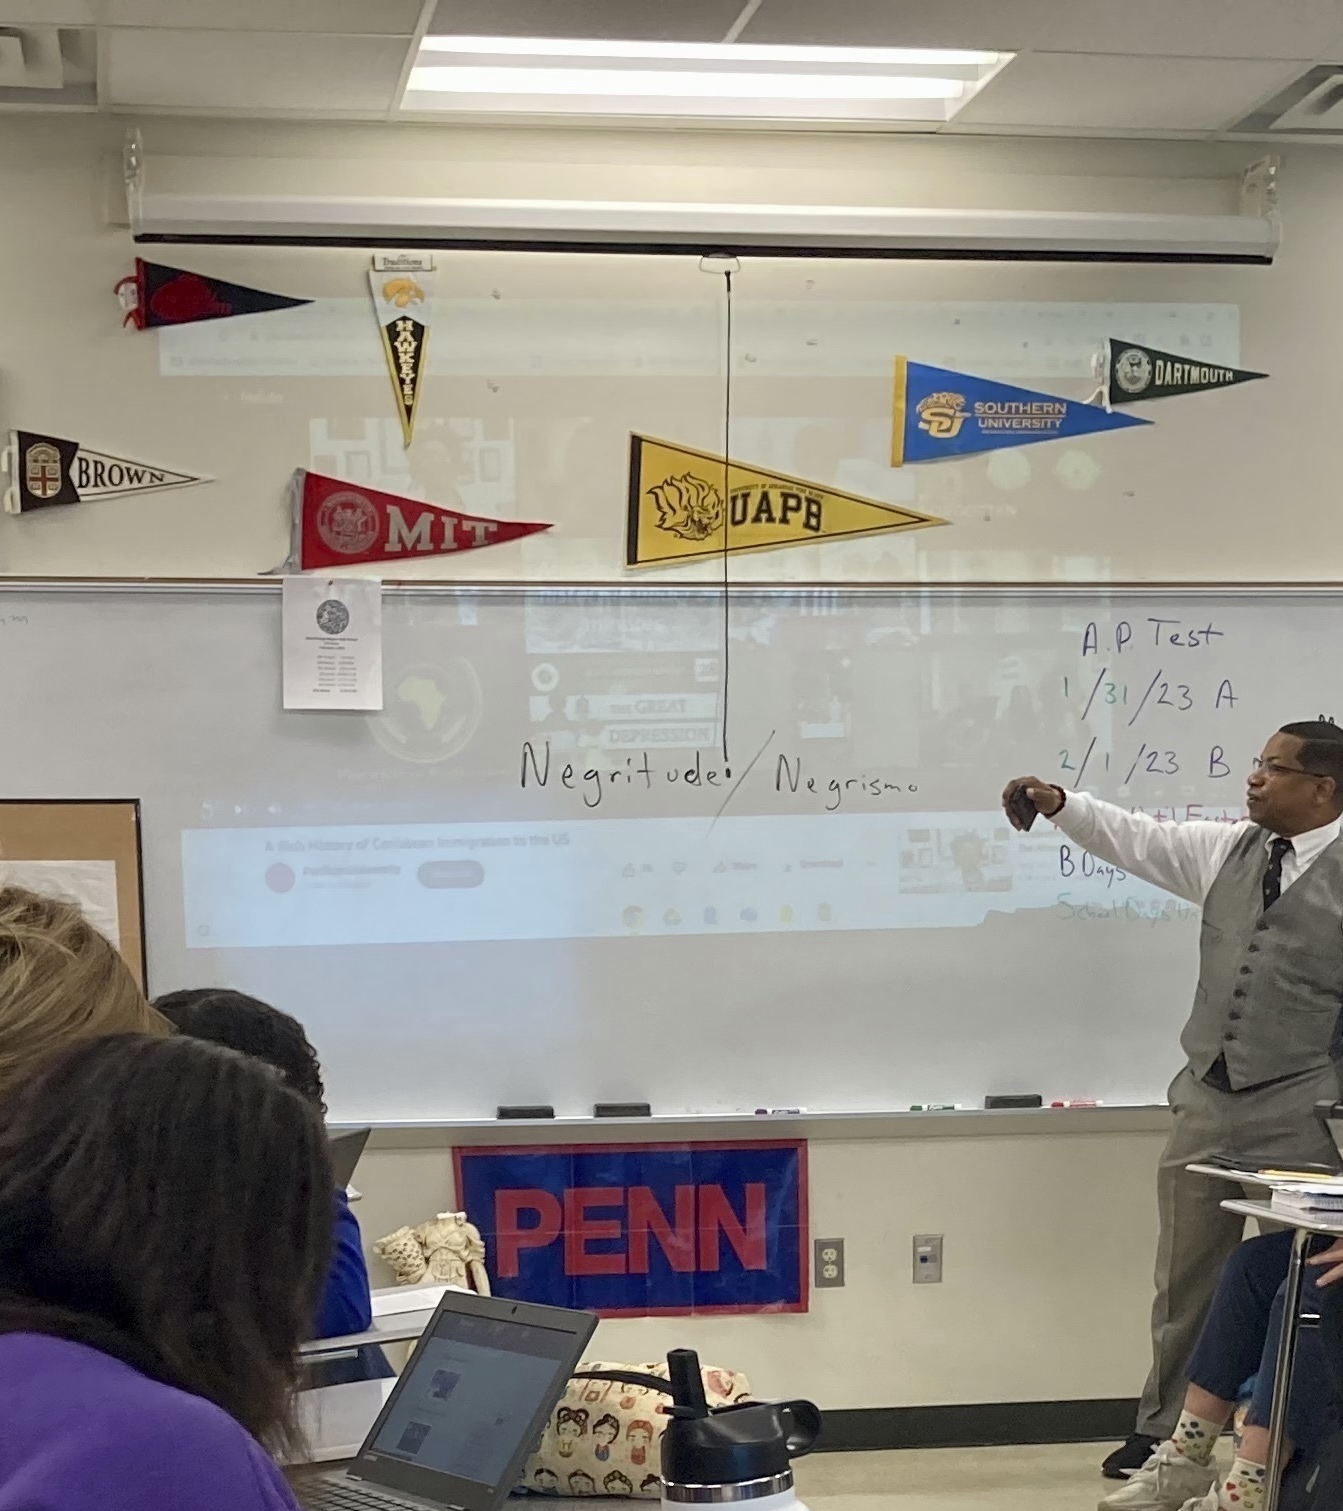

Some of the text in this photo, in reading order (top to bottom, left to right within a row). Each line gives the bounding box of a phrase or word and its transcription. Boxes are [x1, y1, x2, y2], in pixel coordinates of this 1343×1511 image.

[1155, 360, 1233, 386] DARTMOUTH
[974, 402, 1067, 414] SOUTHERN
[978, 418, 1063, 429] UNIVERSITY
[77, 456, 164, 488] BROWN
[729, 490, 823, 533] UAPB
[384, 504, 499, 552] MIT
[1147, 618, 1224, 648] Test
[634, 699, 688, 713] GREAT
[1215, 679, 1238, 709] A
[609, 728, 709, 743] DEPRESSION
[521, 741, 718, 807] Negritude
[776, 754, 918, 810] Negrismo
[1208, 745, 1231, 778] B
[1059, 845, 1075, 877] B
[1082, 850, 1127, 888] Days
[495, 1183, 767, 1278] PENN
